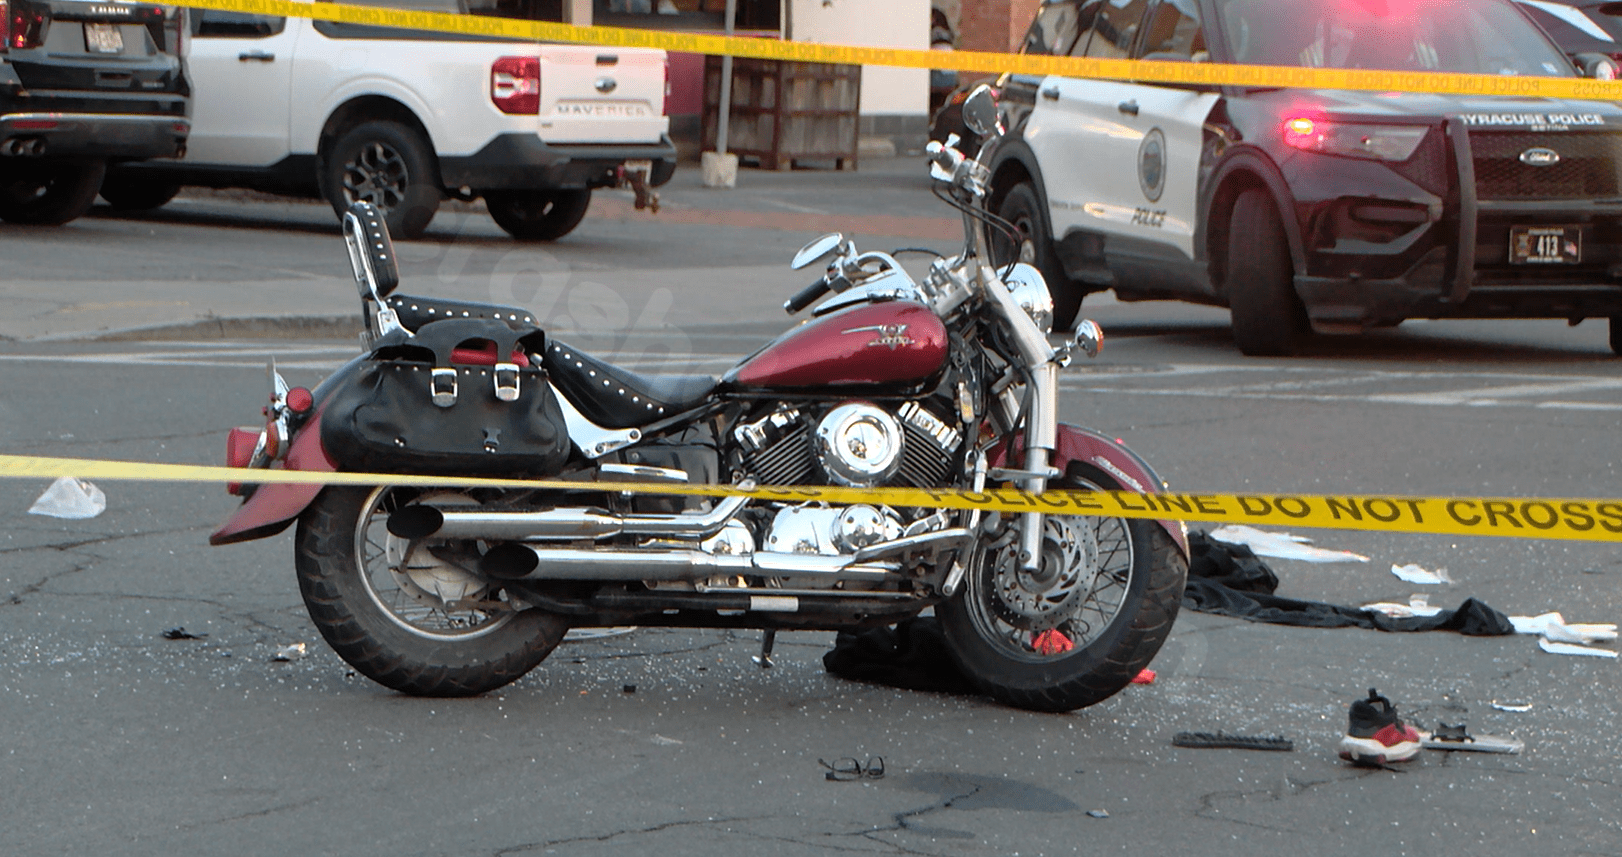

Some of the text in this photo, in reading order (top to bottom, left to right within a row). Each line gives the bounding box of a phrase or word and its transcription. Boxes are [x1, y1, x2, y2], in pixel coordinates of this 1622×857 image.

[558, 104, 645, 116] MAVERICK
[1548, 113, 1606, 127] POLICE
[1130, 206, 1167, 228] POLICE
[1536, 235, 1559, 257] 413
[1109, 489, 1226, 515] LINE
[1235, 496, 1311, 519] DO
[1324, 497, 1426, 524] NOT
[1446, 499, 1622, 533] CROSS
